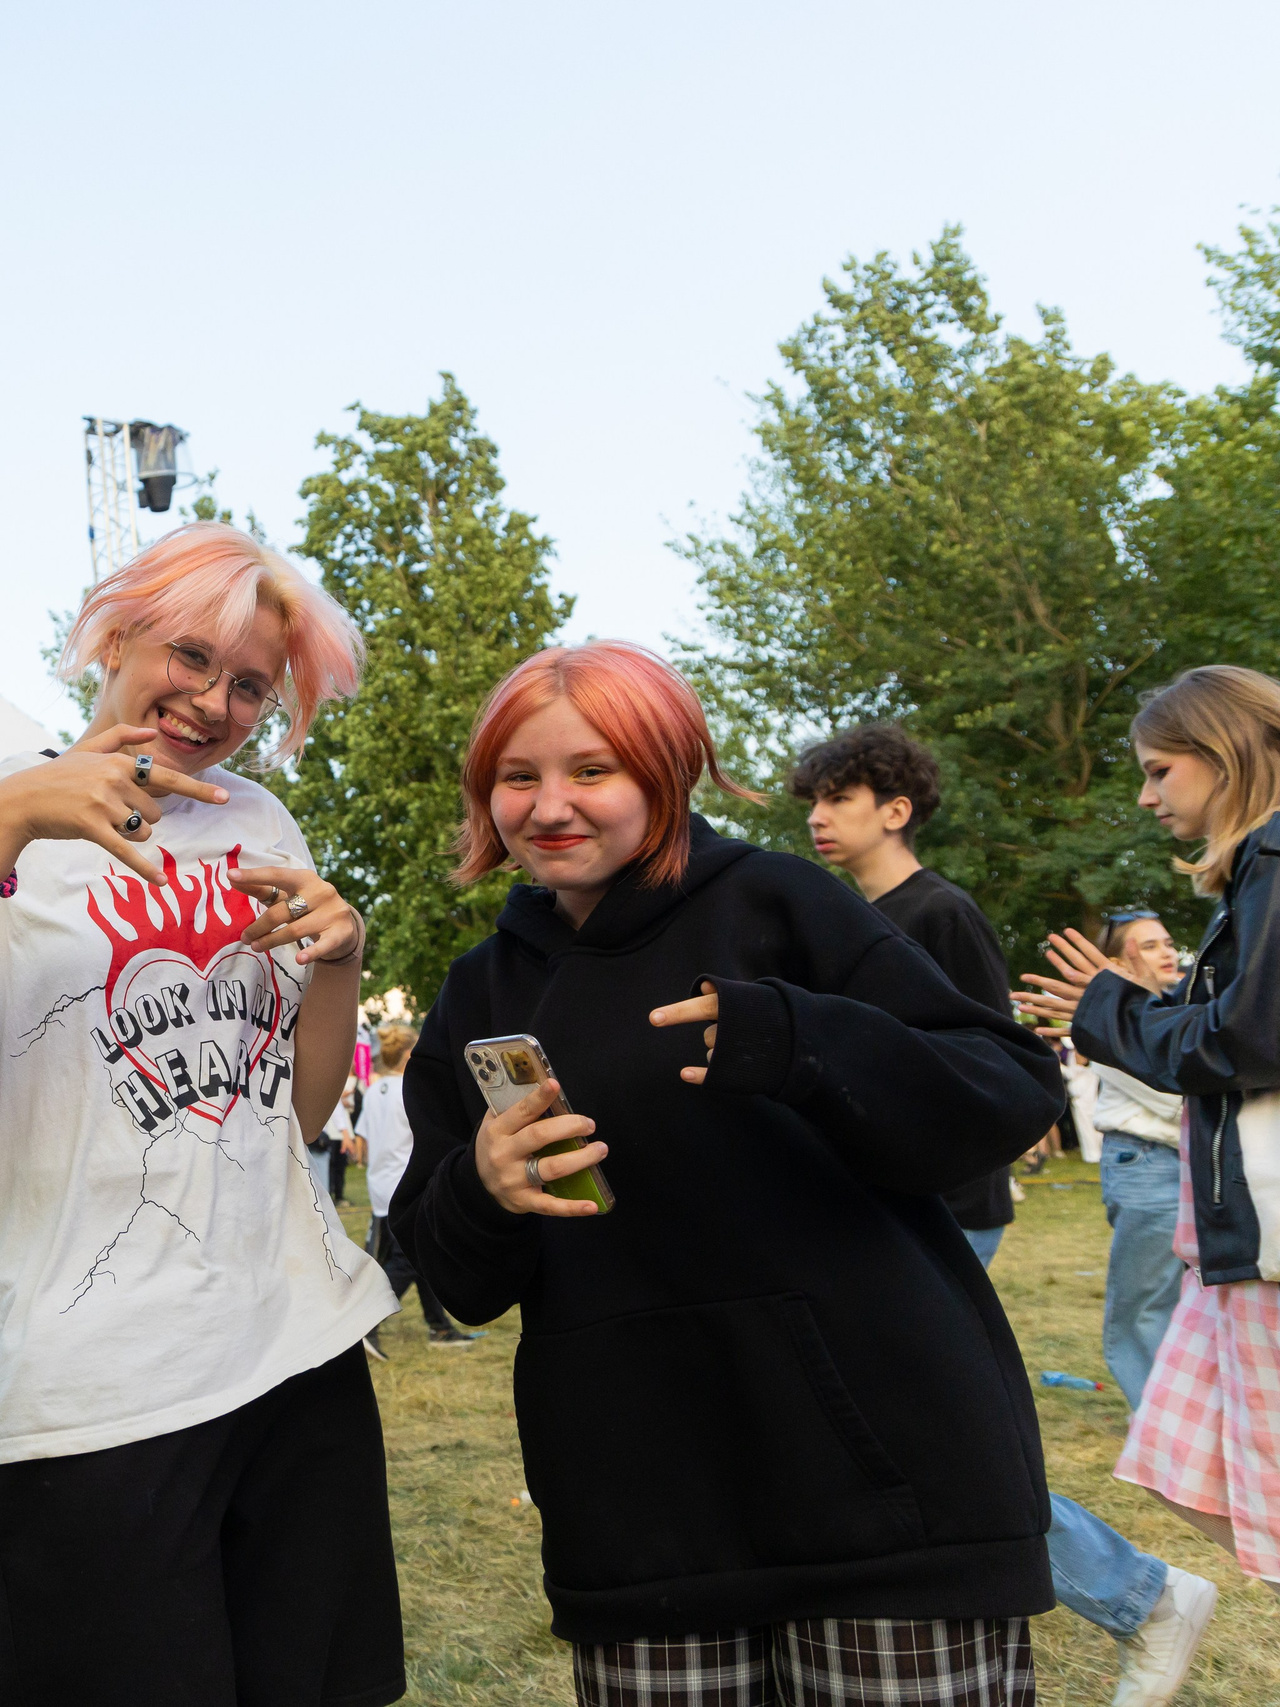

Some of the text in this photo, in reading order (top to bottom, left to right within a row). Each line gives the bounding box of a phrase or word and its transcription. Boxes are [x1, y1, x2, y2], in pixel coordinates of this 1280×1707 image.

[90, 980, 300, 1064] LOOK IN MY
[115, 1039, 291, 1132] HEART
